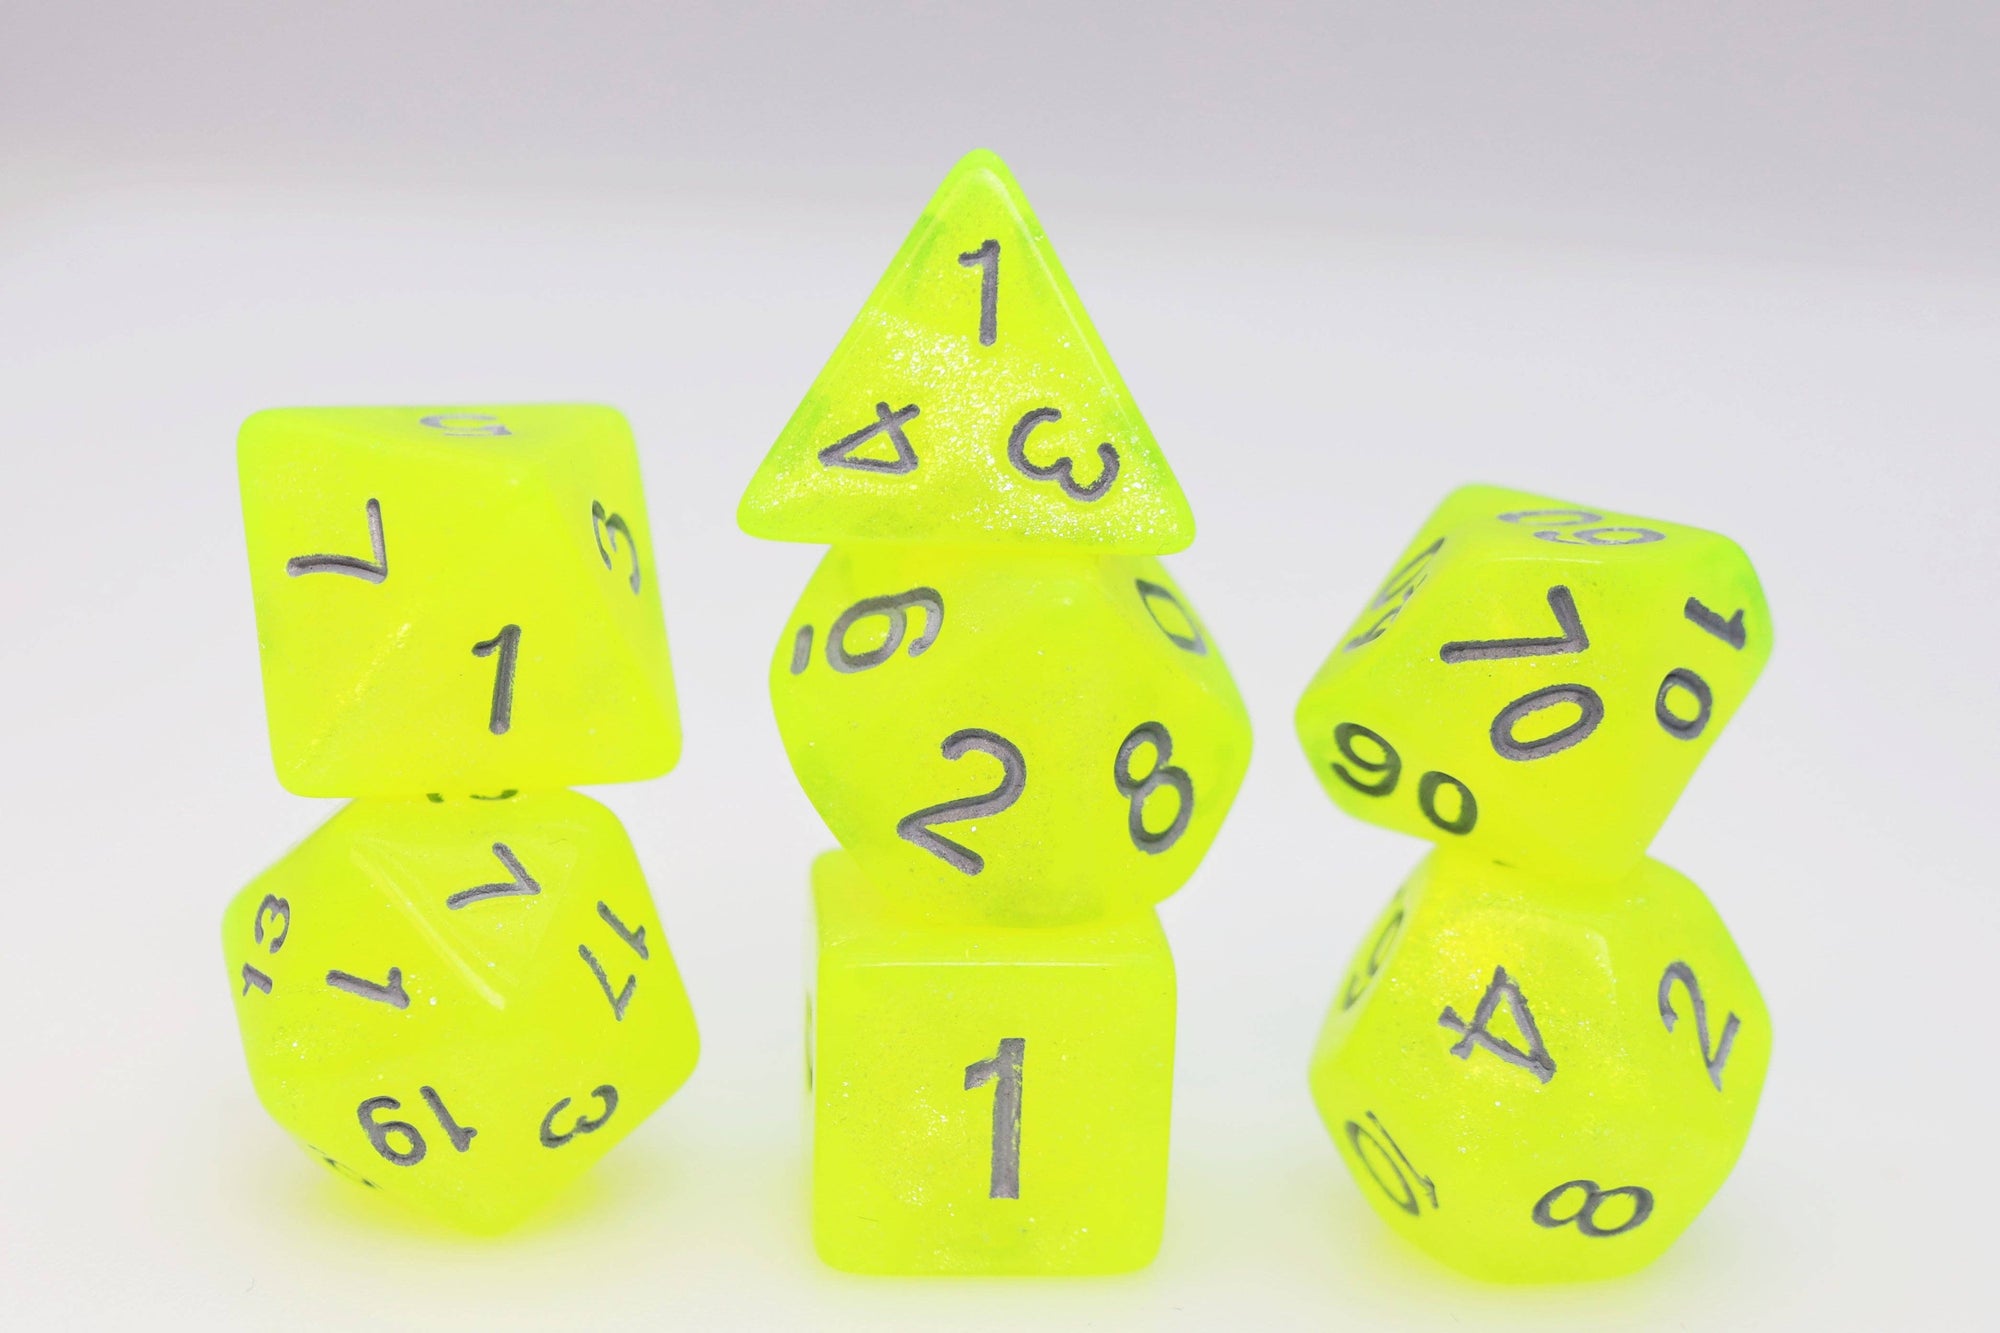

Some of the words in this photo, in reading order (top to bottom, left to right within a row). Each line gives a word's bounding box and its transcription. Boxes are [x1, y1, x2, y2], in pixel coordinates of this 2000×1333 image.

[958, 239, 1001, 347] 1
[818, 402, 921, 475] 4
[1007, 407, 1121, 503] 3
[287, 498, 389, 584] 7
[592, 501, 640, 593] 3
[1135, 579, 1206, 654] 0
[472, 624, 522, 736] 1
[1440, 585, 1605, 762] 70
[1655, 597, 1747, 741] 10
[897, 728, 1027, 877] 2
[1114, 721, 1195, 855] 8
[447, 843, 541, 910] 7
[242, 894, 291, 996] 13
[326, 967, 411, 1010] 1
[579, 901, 649, 1022] 17
[1439, 965, 1557, 1085] 4
[1658, 962, 1741, 1091] 2
[357, 1086, 478, 1167] 19
[540, 1085, 619, 1149] 3
[964, 1038, 1026, 1200] 1
[1532, 1180, 1655, 1238] 8
